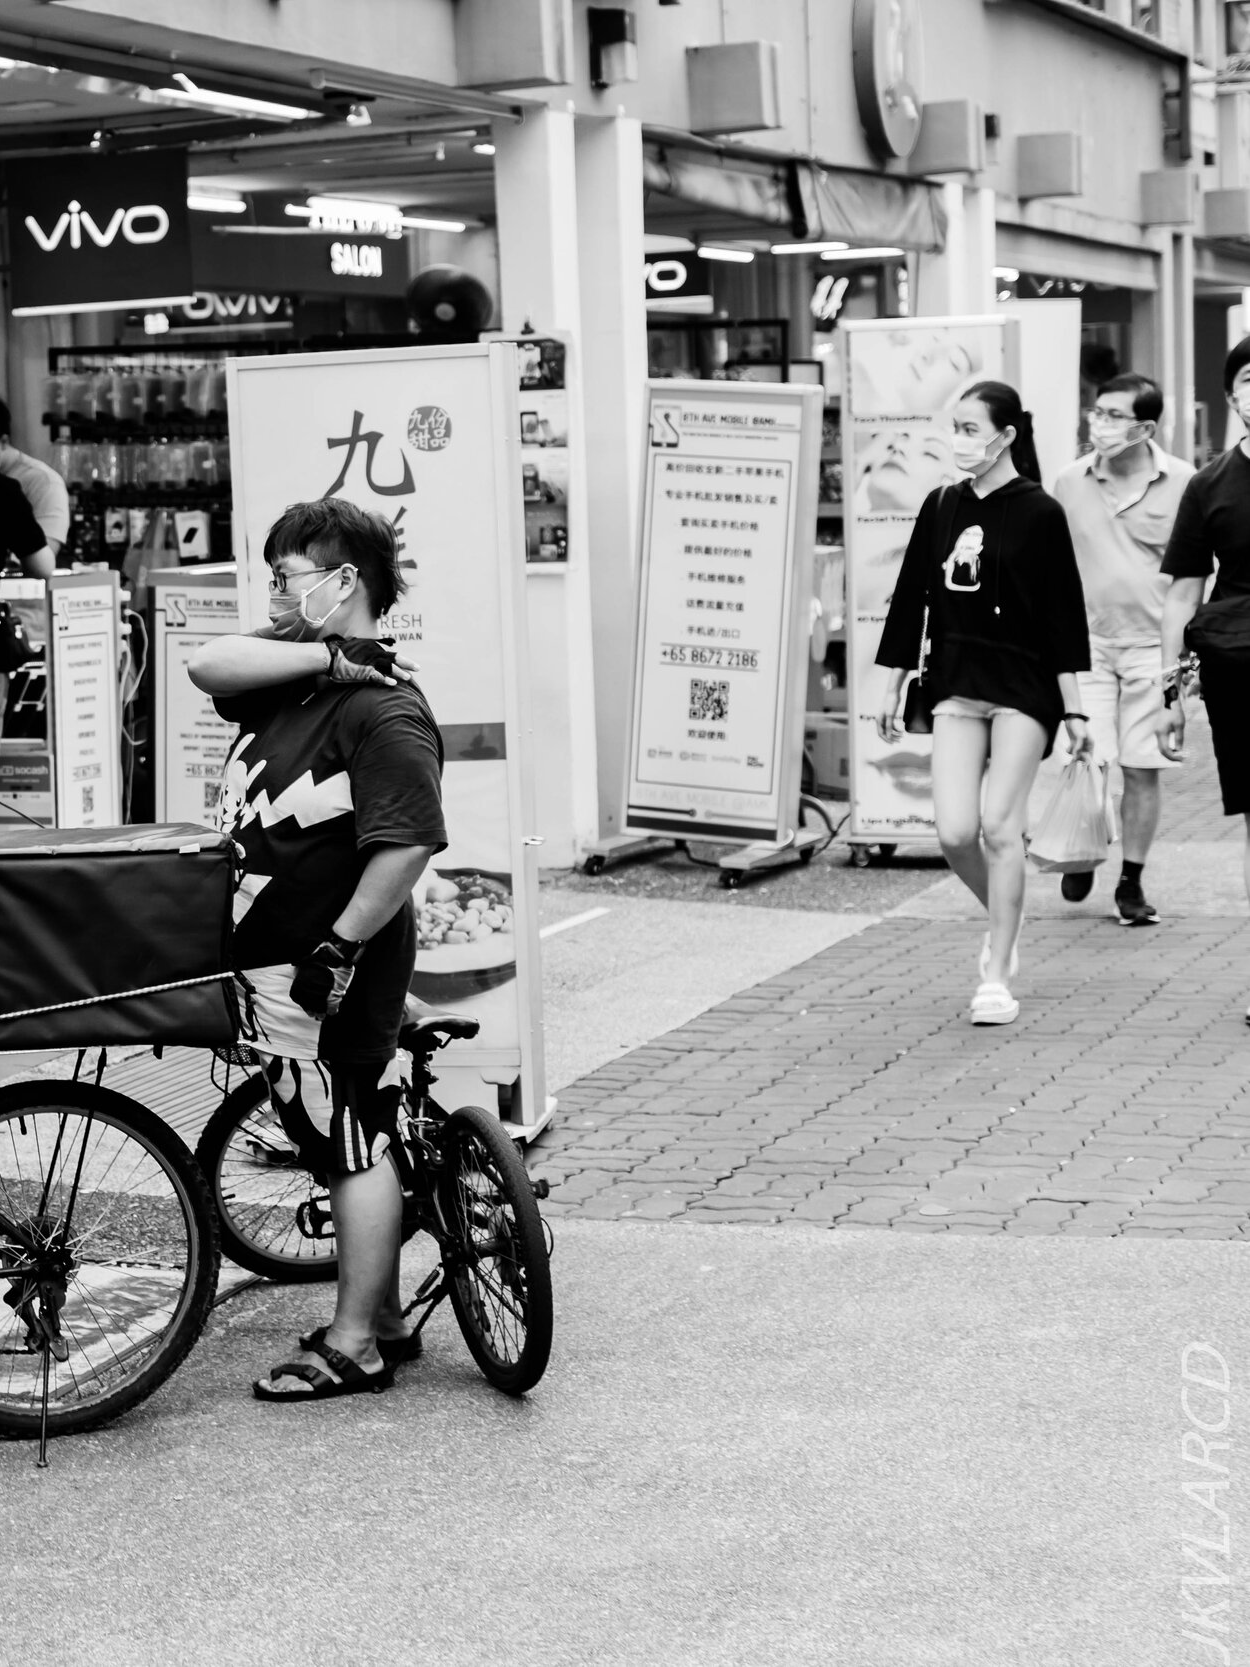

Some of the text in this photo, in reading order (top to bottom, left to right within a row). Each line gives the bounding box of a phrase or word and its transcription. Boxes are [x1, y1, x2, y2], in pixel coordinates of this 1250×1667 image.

[24, 200, 169, 251] vivo
[330, 242, 383, 277] SALON
[880, 415, 932, 423] Threading
[380, 613, 422, 629] RESH
[662, 646, 758, 668] +65 8672 2186
